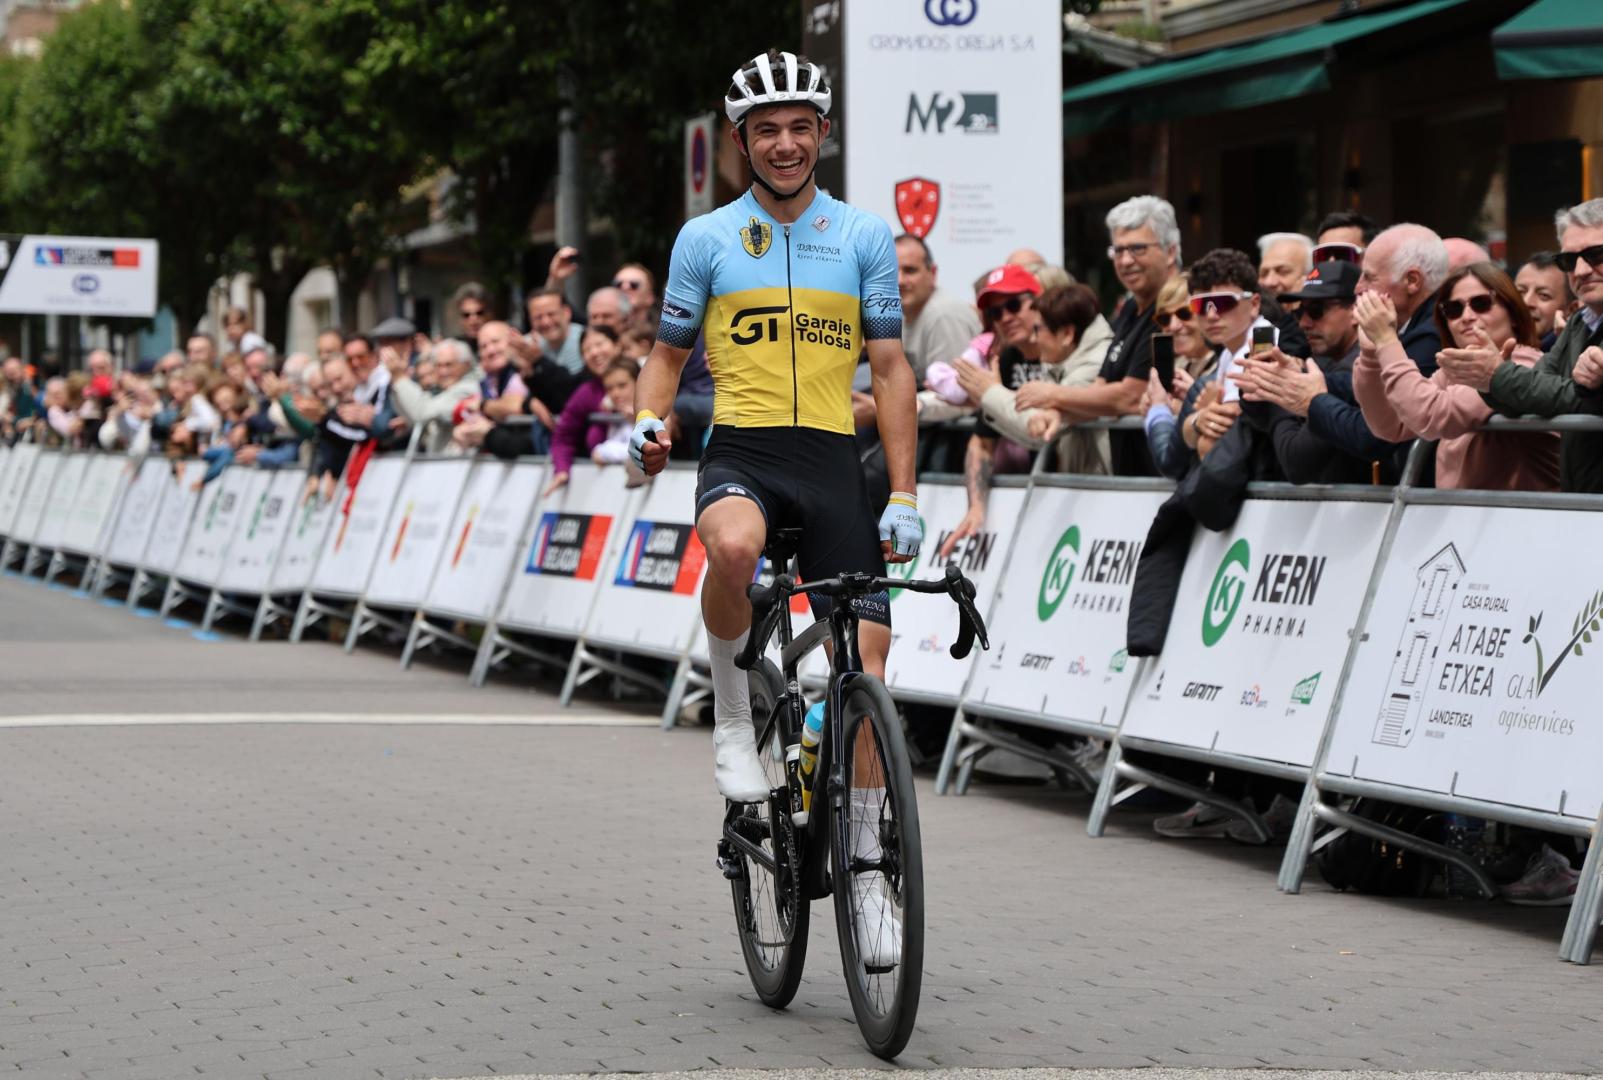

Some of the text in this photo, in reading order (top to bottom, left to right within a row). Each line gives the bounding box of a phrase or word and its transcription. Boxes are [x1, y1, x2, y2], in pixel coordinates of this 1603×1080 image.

[795, 313, 852, 335] Garaje
[795, 327, 851, 350] Tolosa
[1081, 539, 1142, 585] KERN
[1252, 553, 1327, 606] KERN
[1072, 593, 1124, 614] PHARMA
[1462, 595, 1510, 612] CASA RURAL
[1242, 614, 1307, 638] PHARMA
[1448, 623, 1511, 659] ATABE
[1182, 681, 1224, 701] GIANT
[1438, 662, 1496, 698] ETXEA
[1428, 708, 1474, 728] LANDETXEA
[1498, 706, 1575, 736] agriservices
